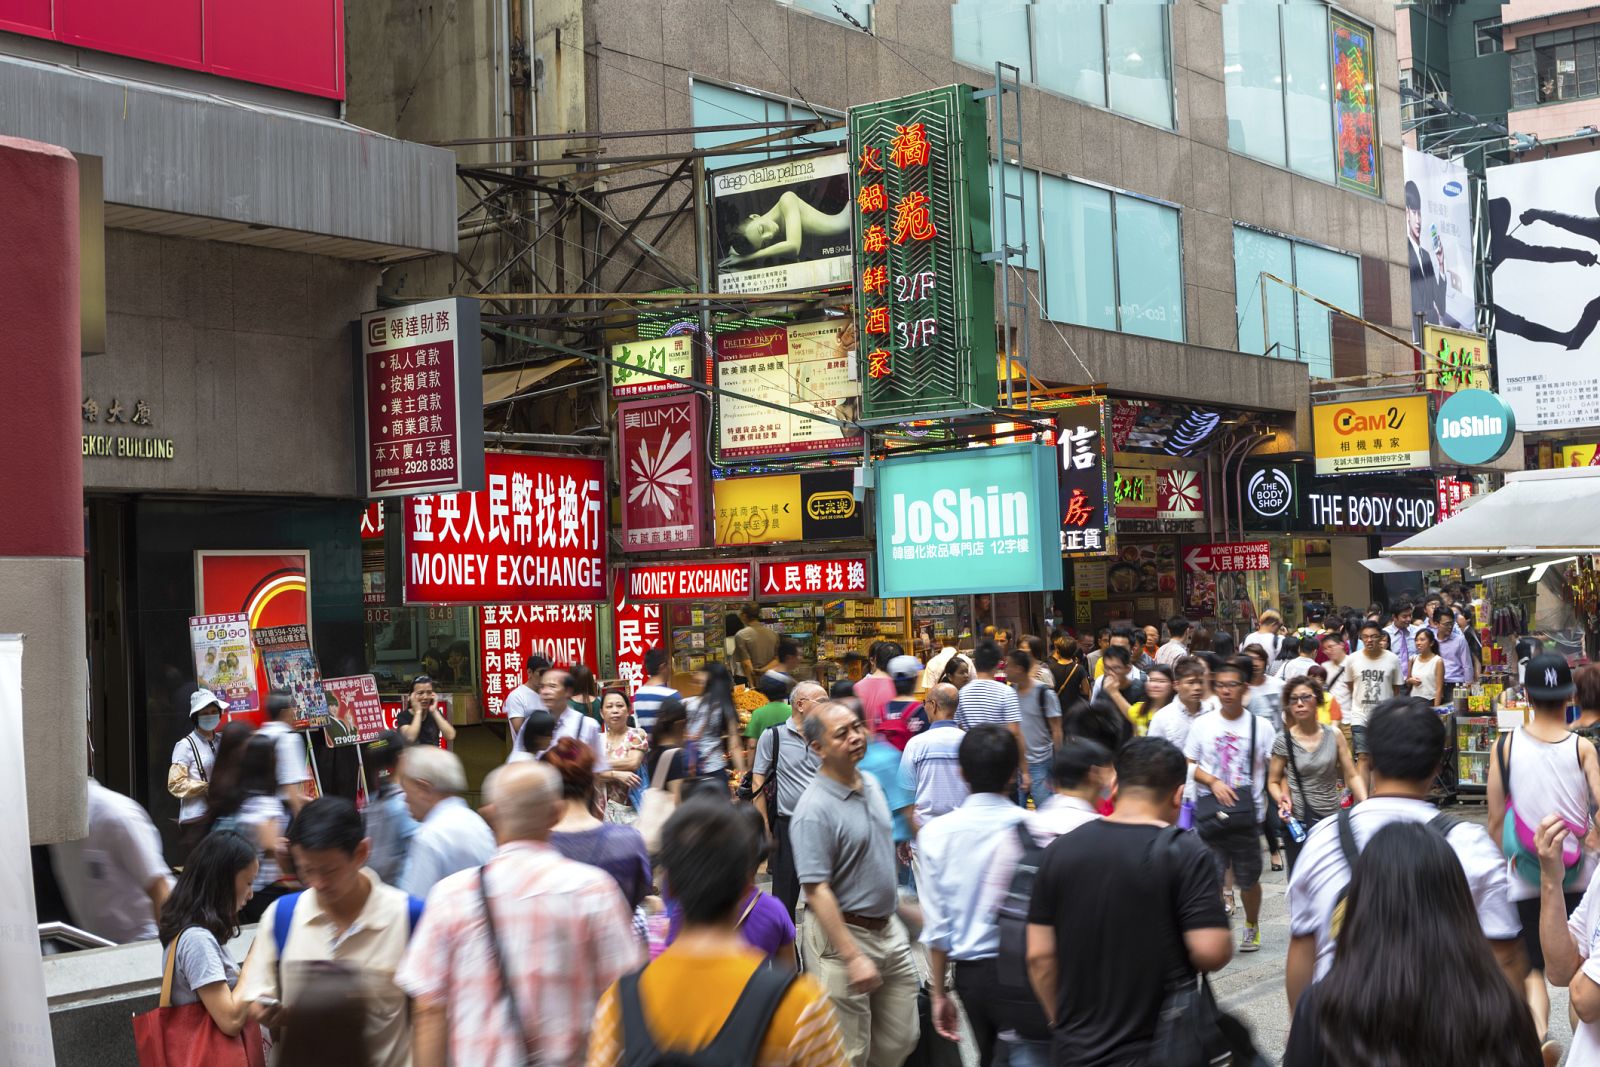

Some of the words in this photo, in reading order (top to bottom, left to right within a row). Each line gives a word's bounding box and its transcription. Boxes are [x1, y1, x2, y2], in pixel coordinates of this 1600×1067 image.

[719, 175, 748, 190] diego
[749, 166, 777, 184] dalla
[777, 161, 815, 182] palma
[858, 144, 892, 379] 火鍋海鮮酒家
[896, 272, 935, 302] 2/F
[391, 310, 450, 340] 領達財務
[897, 319, 937, 350] 3/F
[390, 348, 440, 372] 私人貸款
[673, 365, 686, 375] 5/F
[390, 370, 441, 394] 按揭貸款
[391, 393, 442, 416] 業主貸款
[392, 414, 443, 437] 商業貸款
[1441, 415, 1502, 439] JoShin
[118, 437, 174, 459] BUILDING
[375, 439, 451, 462] 本大廈4字樓
[1058, 425, 1098, 471] 信
[1340, 437, 1400, 452] 相機專家
[405, 460, 428, 474] 2928
[430, 457, 454, 471] 8383
[1257, 490, 1284, 500] BODY
[1262, 483, 1278, 491] THE
[413, 471, 601, 550] 金英人民幣找換行
[891, 485, 1029, 545] JoShin
[1064, 488, 1095, 527] 房
[1258, 498, 1283, 508] SHOP
[1309, 494, 1344, 526] THE
[1349, 495, 1393, 527] BODY
[1396, 498, 1435, 528] SHOP
[892, 541, 984, 561] 韓國化妝品專門店
[990, 538, 1029, 555] 12字樓
[1211, 546, 1233, 556] MONEY
[1234, 543, 1269, 554] EXCHANGE
[411, 552, 489, 586] MONEY
[496, 555, 602, 587] EXCHANGE
[1210, 553, 1270, 571] 人民幣找換
[631, 571, 675, 596] MONEY
[679, 568, 749, 594] EXCHANGE
[764, 562, 865, 593] 人民幣找換
[367, 609, 389, 622] 802
[429, 607, 453, 620] 848
[531, 637, 586, 668] MONEY
[485, 629, 503, 716] 國內匯款
[1361, 669, 1385, 682] 199X
[342, 734, 361, 744] 9022
